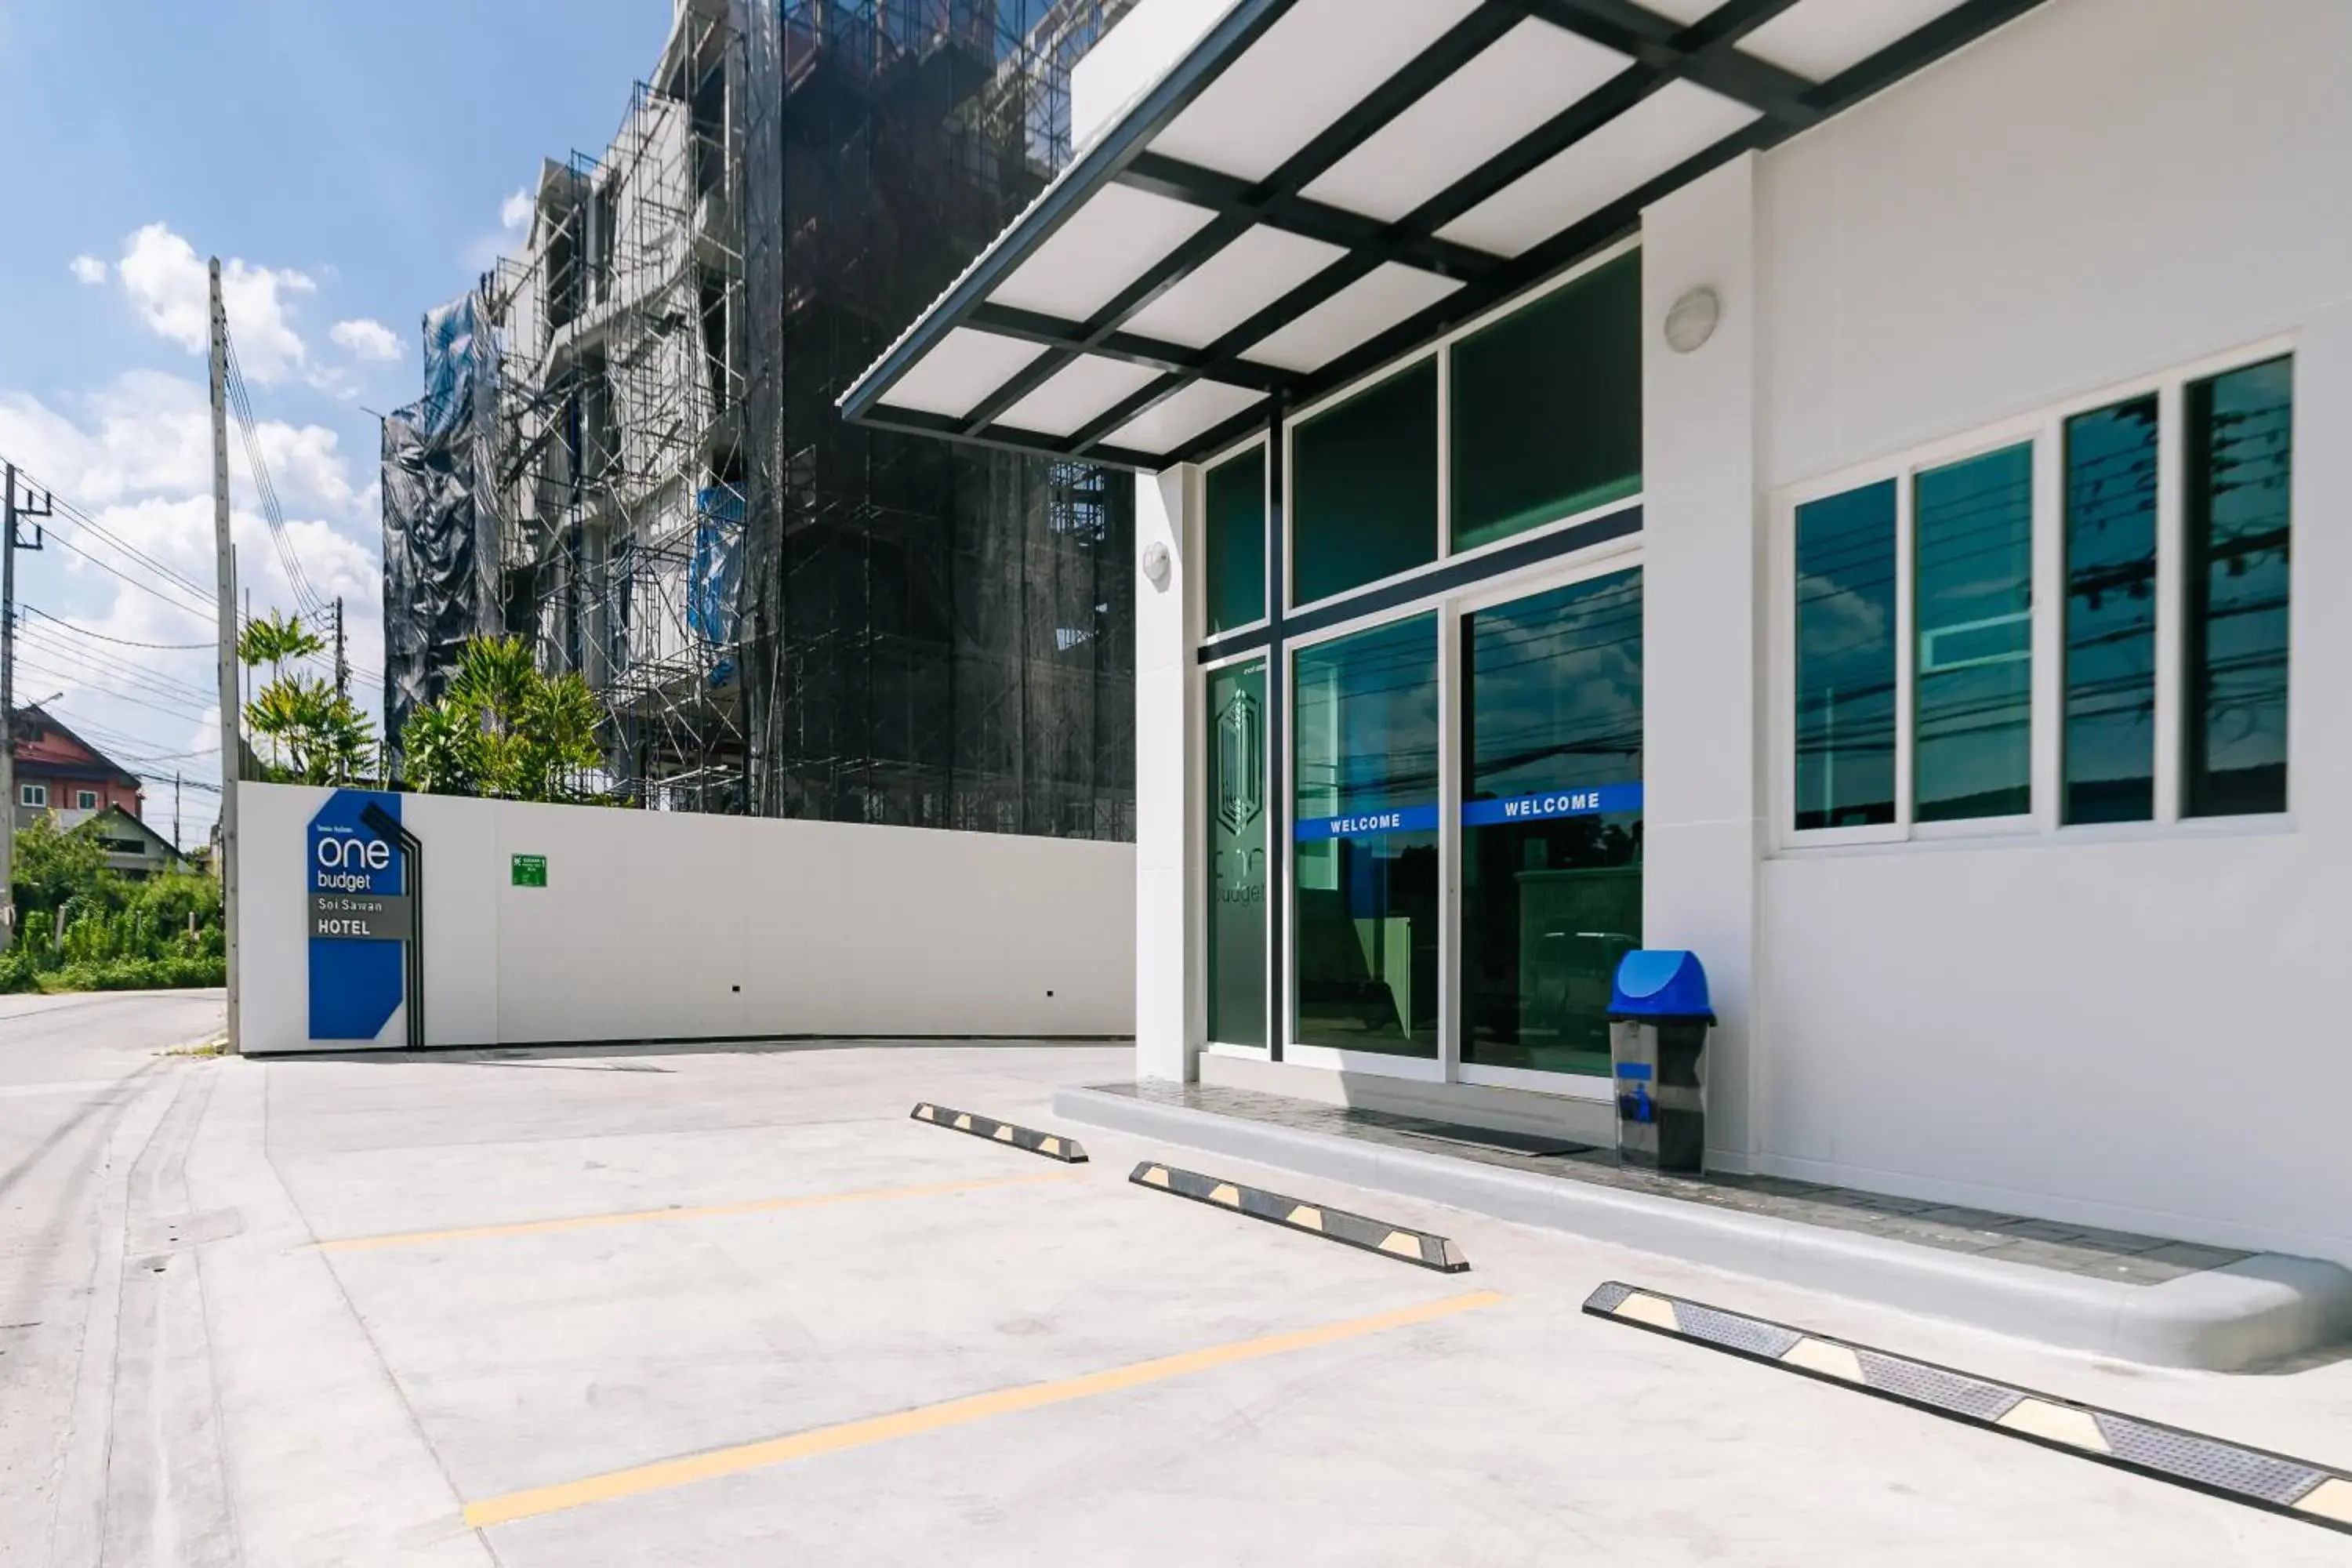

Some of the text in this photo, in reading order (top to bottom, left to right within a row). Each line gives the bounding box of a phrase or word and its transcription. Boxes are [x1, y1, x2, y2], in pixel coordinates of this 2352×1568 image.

[1504, 793, 1600, 816] WELCOME
[1330, 813, 1400, 833] WELCOME
[318, 837, 389, 869] one
[318, 869, 371, 892] budget
[318, 898, 338, 910] Soi
[318, 919, 370, 935] HOTEL
